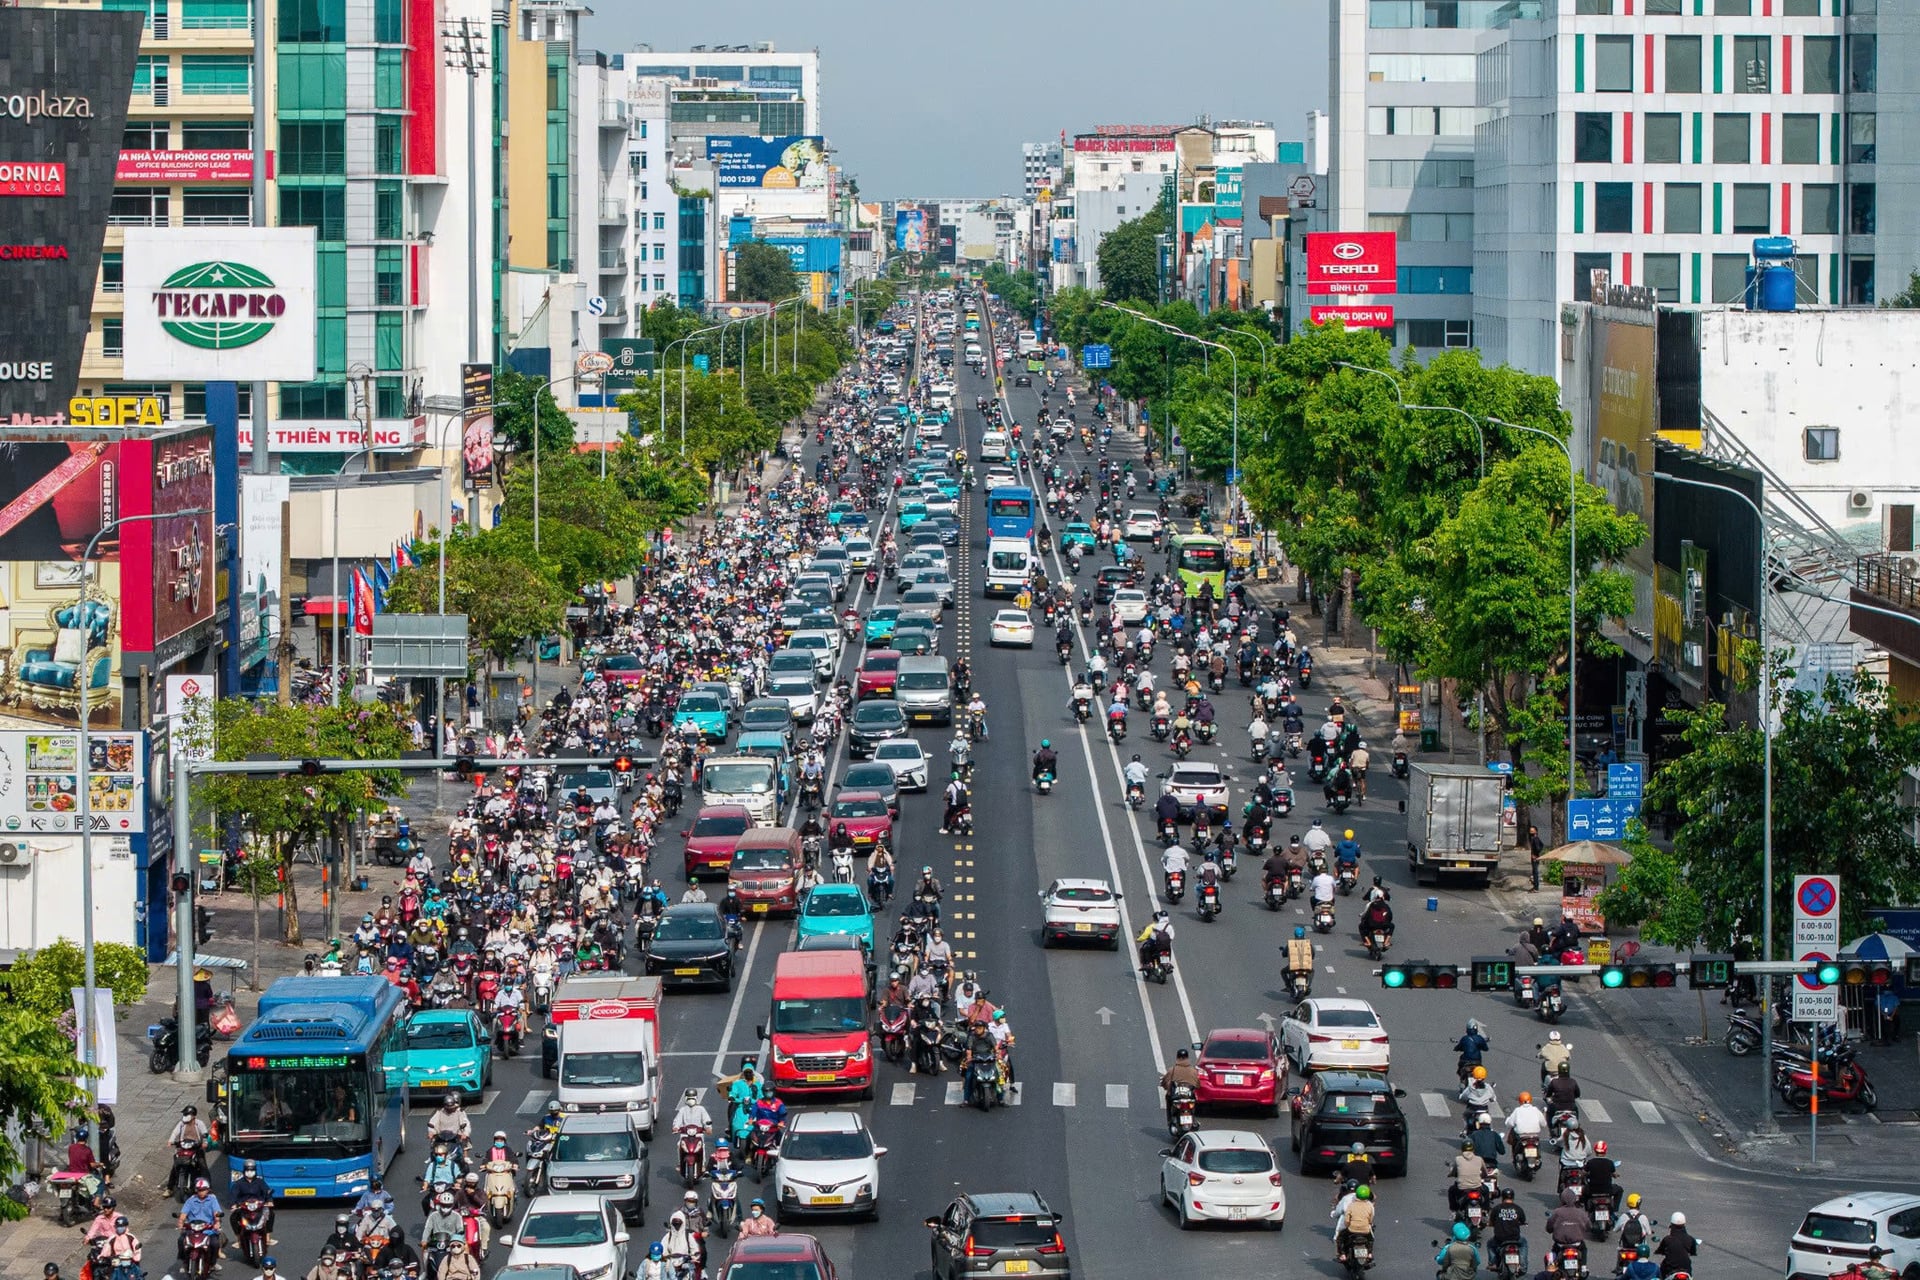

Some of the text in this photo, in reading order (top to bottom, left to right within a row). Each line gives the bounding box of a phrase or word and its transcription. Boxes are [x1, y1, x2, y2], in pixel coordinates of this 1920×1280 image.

[210, 153, 231, 161] CHO
[25, 184, 61, 192] YOGA
[0, 245, 68, 260] CINEMA
[1320, 264, 1378, 274] TERACO
[1330, 283, 1350, 292] BÌNH
[152, 292, 286, 318] TECAPRO
[1352, 312, 1372, 323] DỊCH
[1375, 312, 1387, 321] VỤ
[69, 397, 164, 426] SOFA
[11, 412, 66, 426] Mart
[276, 428, 331, 443] THIÊN
[337, 431, 400, 443] TRANG
